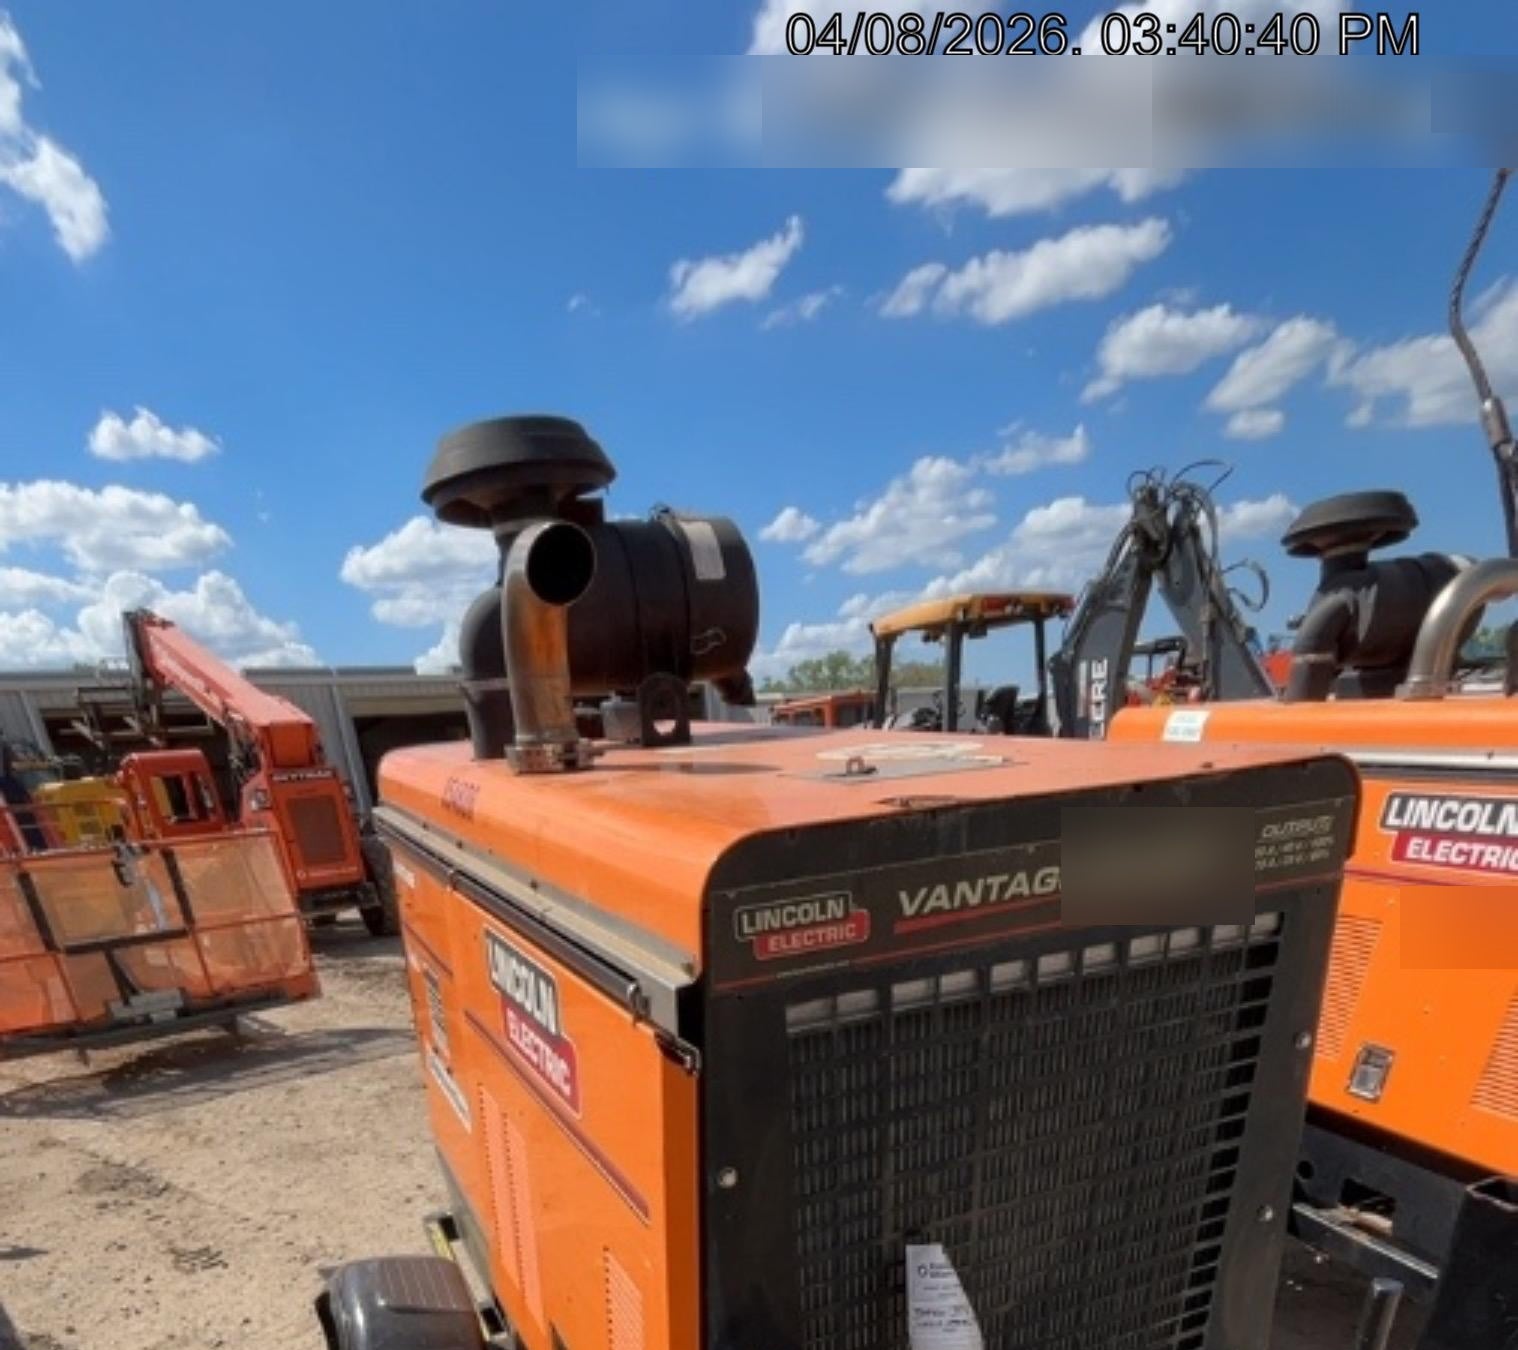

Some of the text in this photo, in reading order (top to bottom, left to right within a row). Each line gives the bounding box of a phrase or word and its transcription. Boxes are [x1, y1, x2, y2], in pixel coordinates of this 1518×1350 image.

[1385, 797, 1518, 835] LINCOLN
[899, 865, 1061, 917] VANTAG
[740, 897, 844, 934] LINCOLN
[767, 922, 856, 951] ELECTRIC
[490, 938, 556, 1036] LINCOLN
[505, 1005, 571, 1098] ELECTRIC
